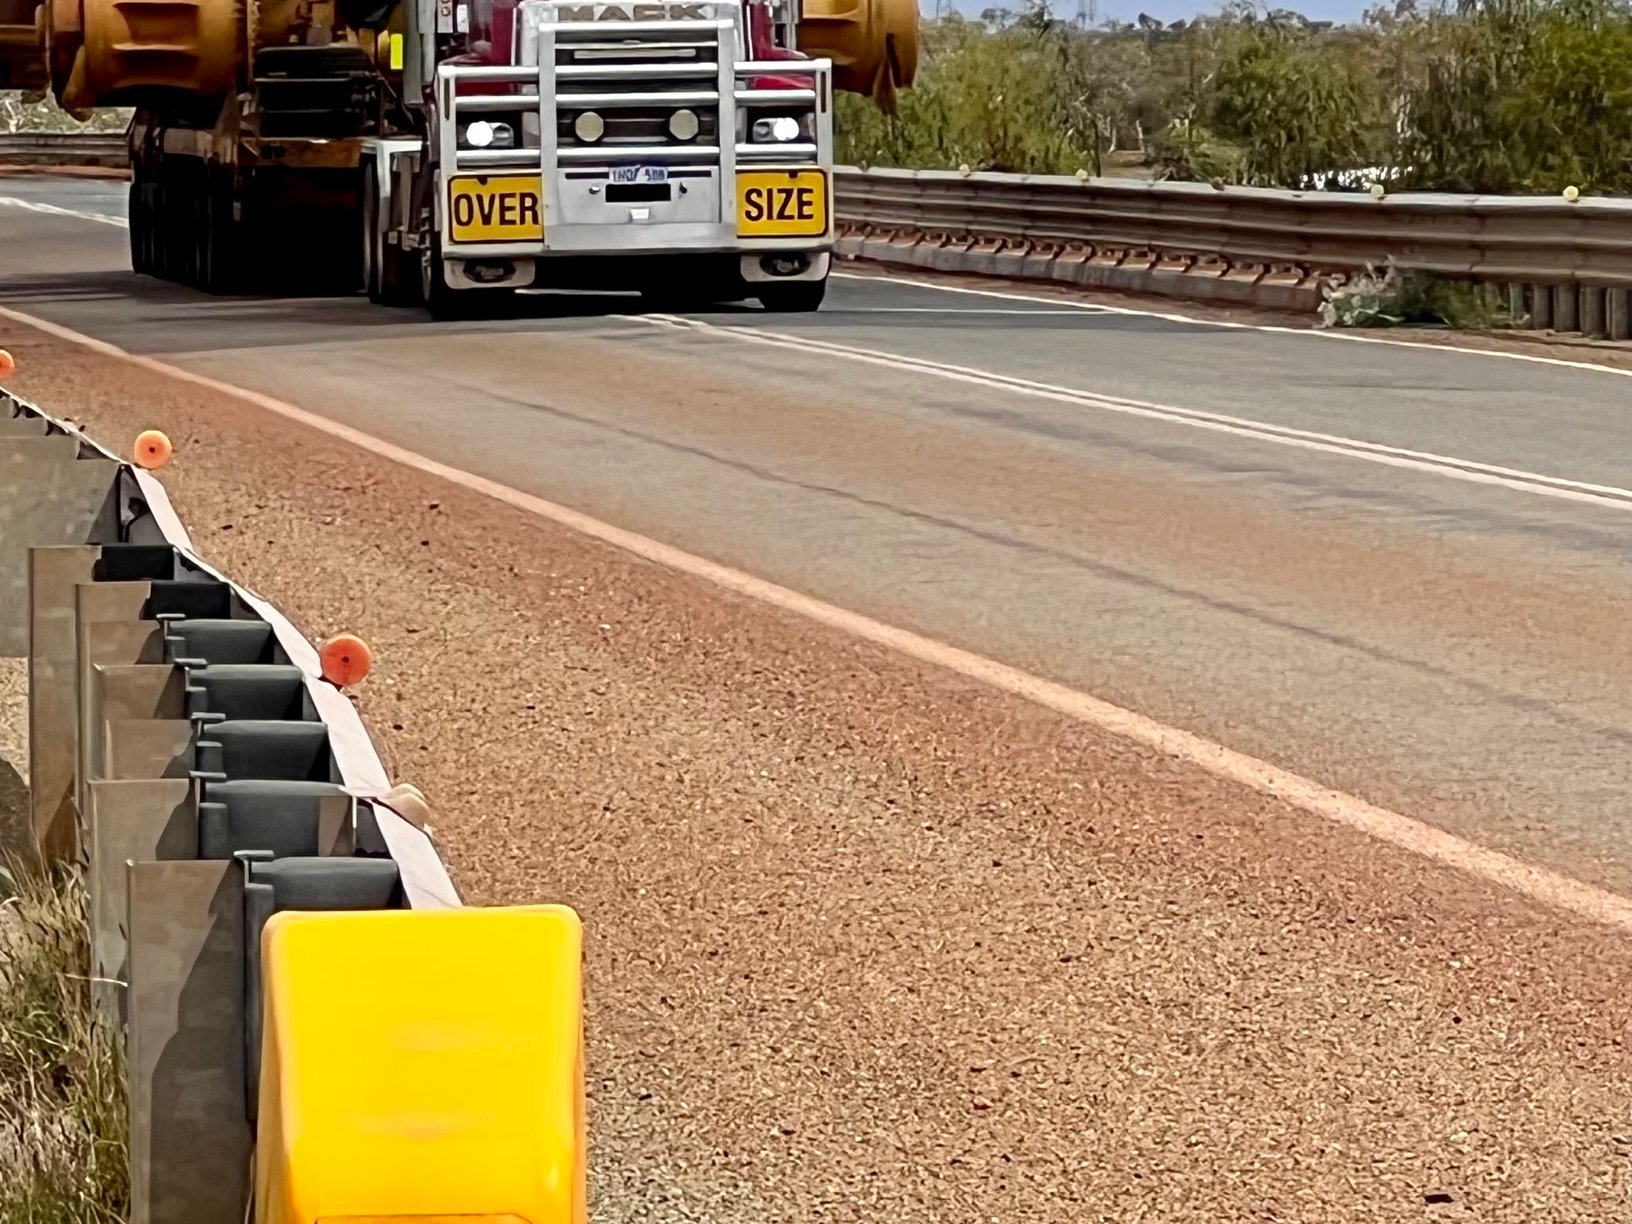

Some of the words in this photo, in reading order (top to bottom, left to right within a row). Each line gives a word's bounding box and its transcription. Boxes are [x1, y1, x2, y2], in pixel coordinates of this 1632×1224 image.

[557, 4, 707, 21] MACK
[454, 192, 540, 227] OVER
[744, 187, 814, 222] SIZE
